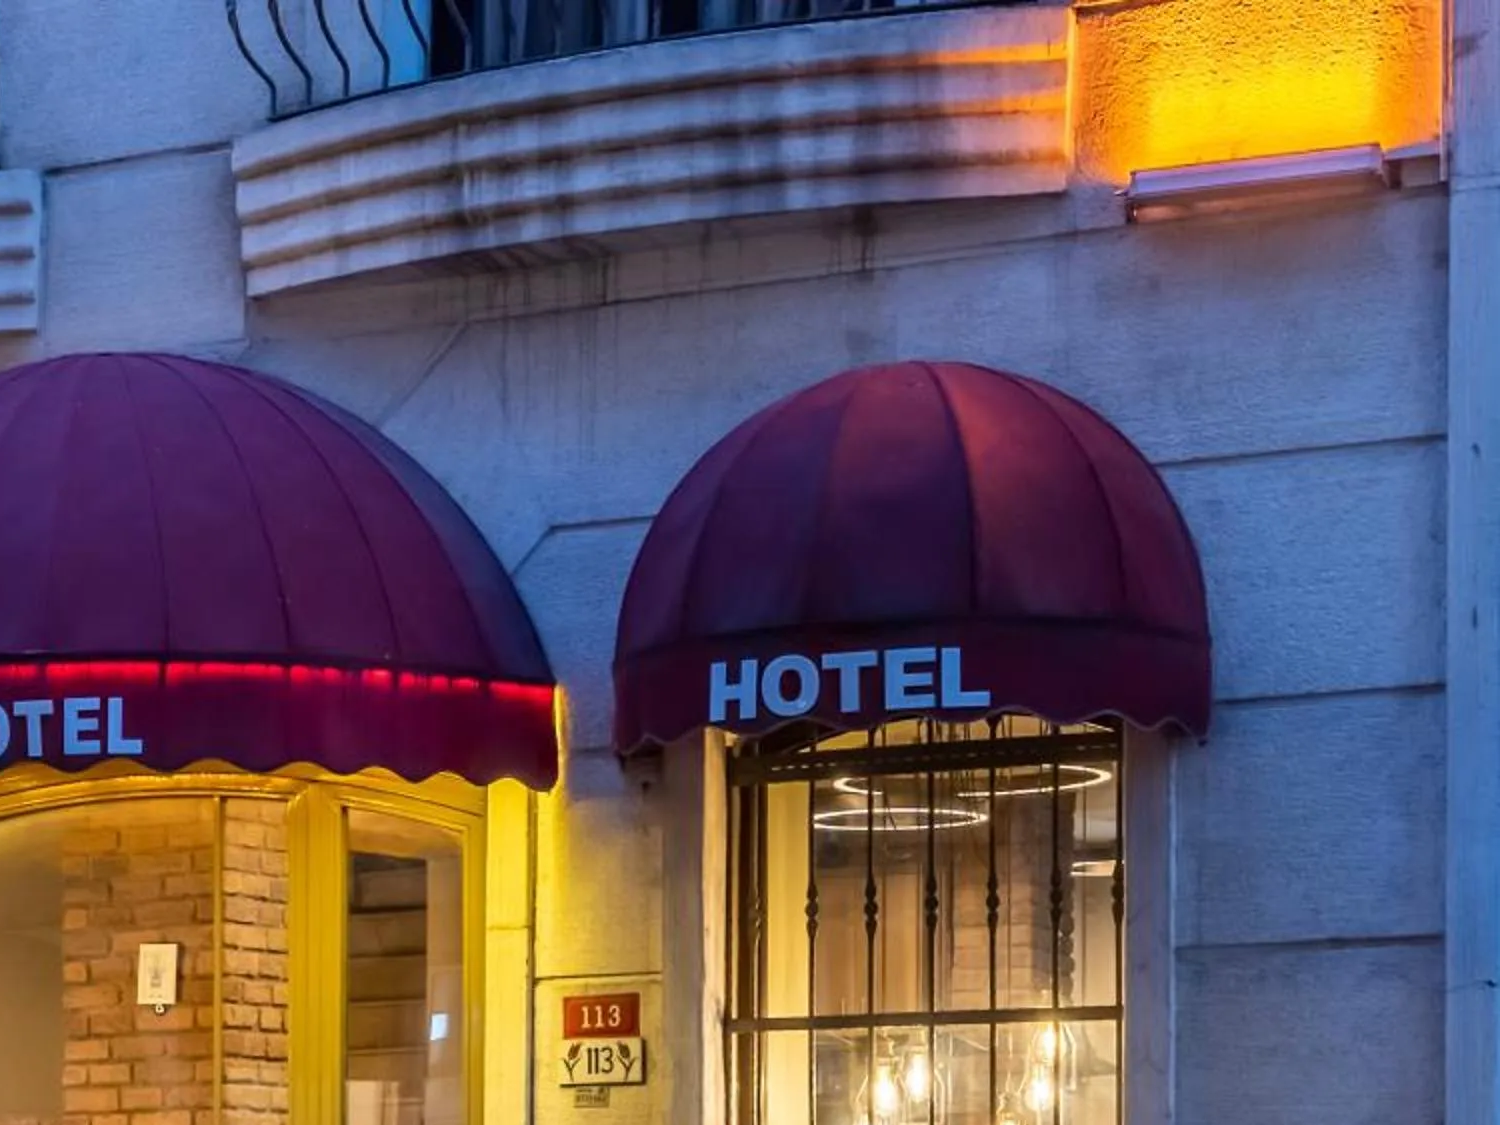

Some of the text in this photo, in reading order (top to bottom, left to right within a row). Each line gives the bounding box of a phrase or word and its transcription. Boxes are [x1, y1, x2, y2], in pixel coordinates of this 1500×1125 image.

[709, 647, 991, 723] HOTEL
[581, 1005, 621, 1029] 113
[586, 1047, 614, 1075] 113
